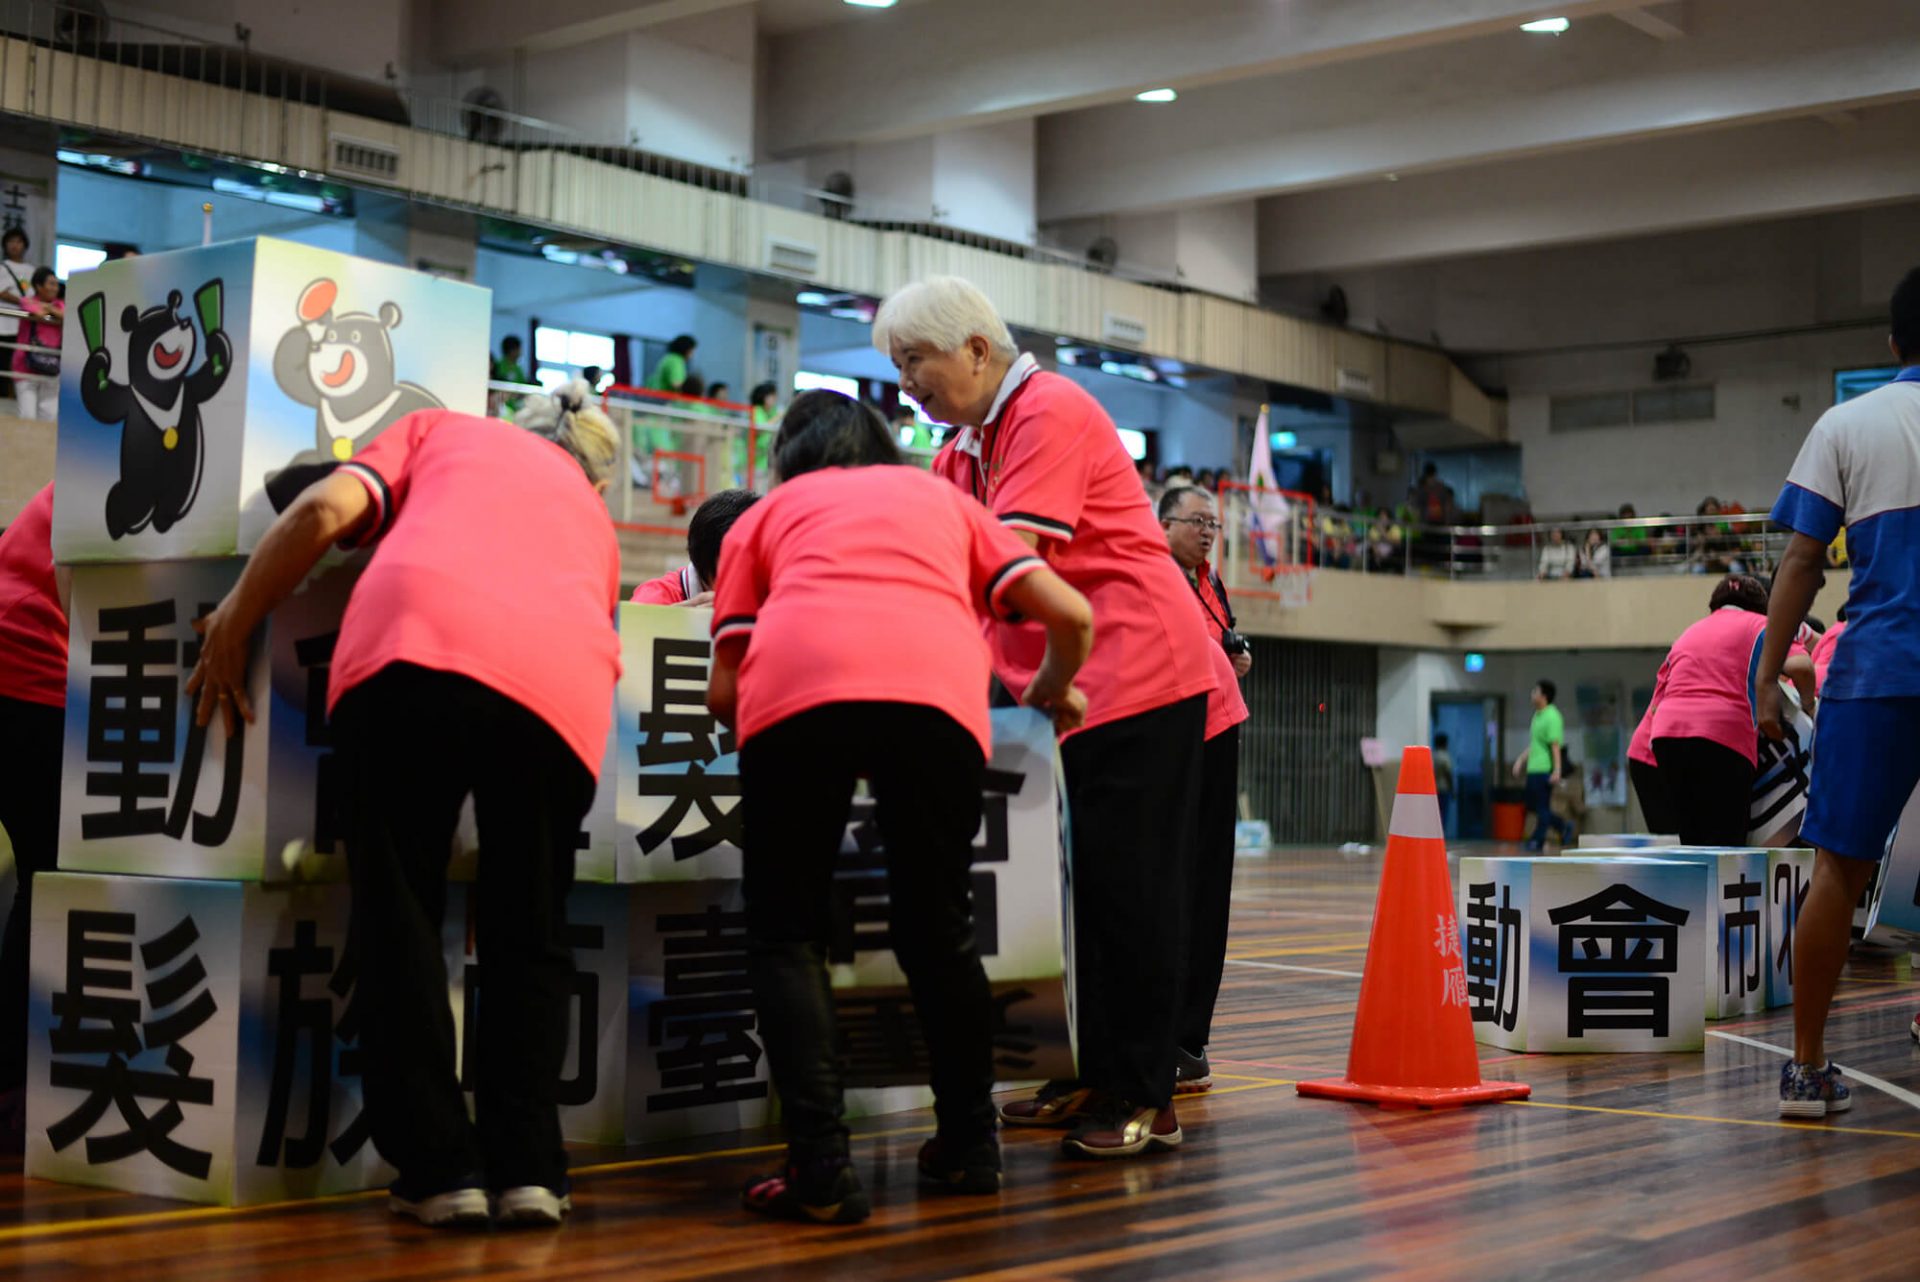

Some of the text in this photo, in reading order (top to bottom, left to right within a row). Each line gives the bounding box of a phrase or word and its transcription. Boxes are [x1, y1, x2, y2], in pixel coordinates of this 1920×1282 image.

[82, 599, 245, 847] 動
[1467, 882, 1521, 1032] 動
[1548, 883, 1690, 1037] 會
[1724, 873, 1762, 997] 市
[46, 909, 217, 1179] 髮
